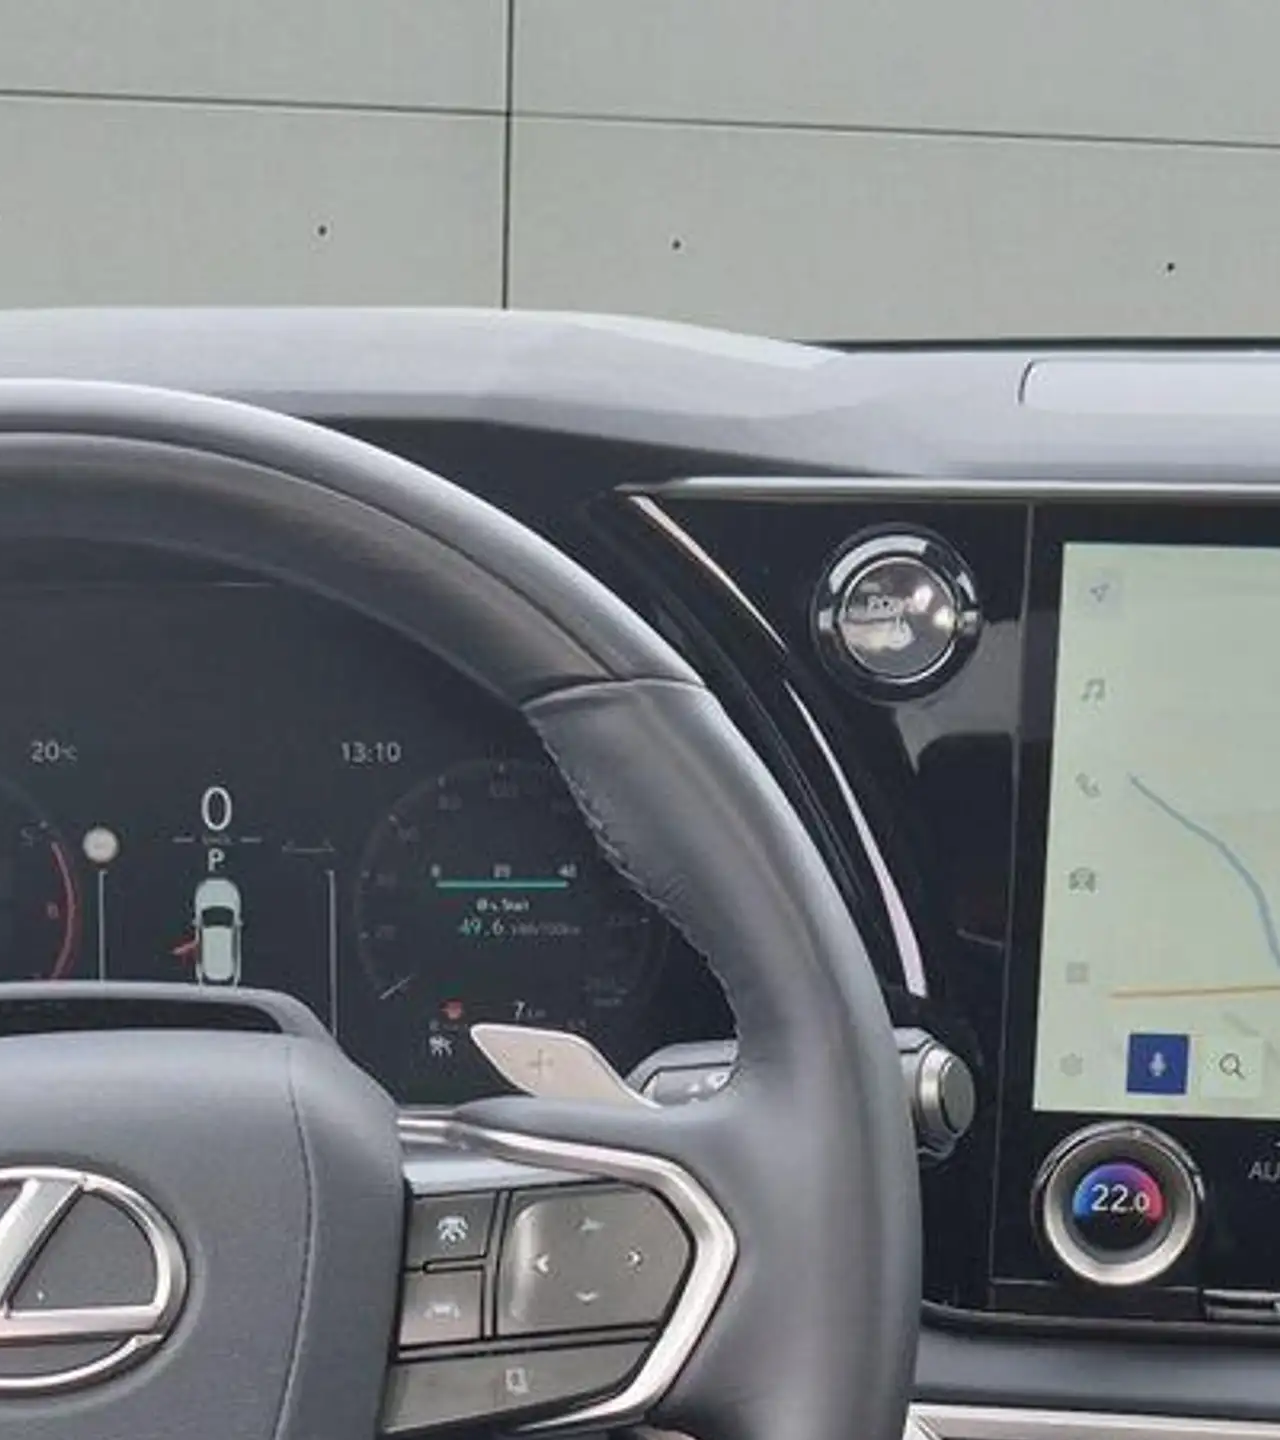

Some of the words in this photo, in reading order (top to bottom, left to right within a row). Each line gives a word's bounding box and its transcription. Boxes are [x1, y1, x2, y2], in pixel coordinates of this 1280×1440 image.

[341, 741, 402, 763] 13:10
[202, 786, 233, 831] 0
[208, 847, 226, 872] P
[1091, 1183, 1151, 1213] 22.0
